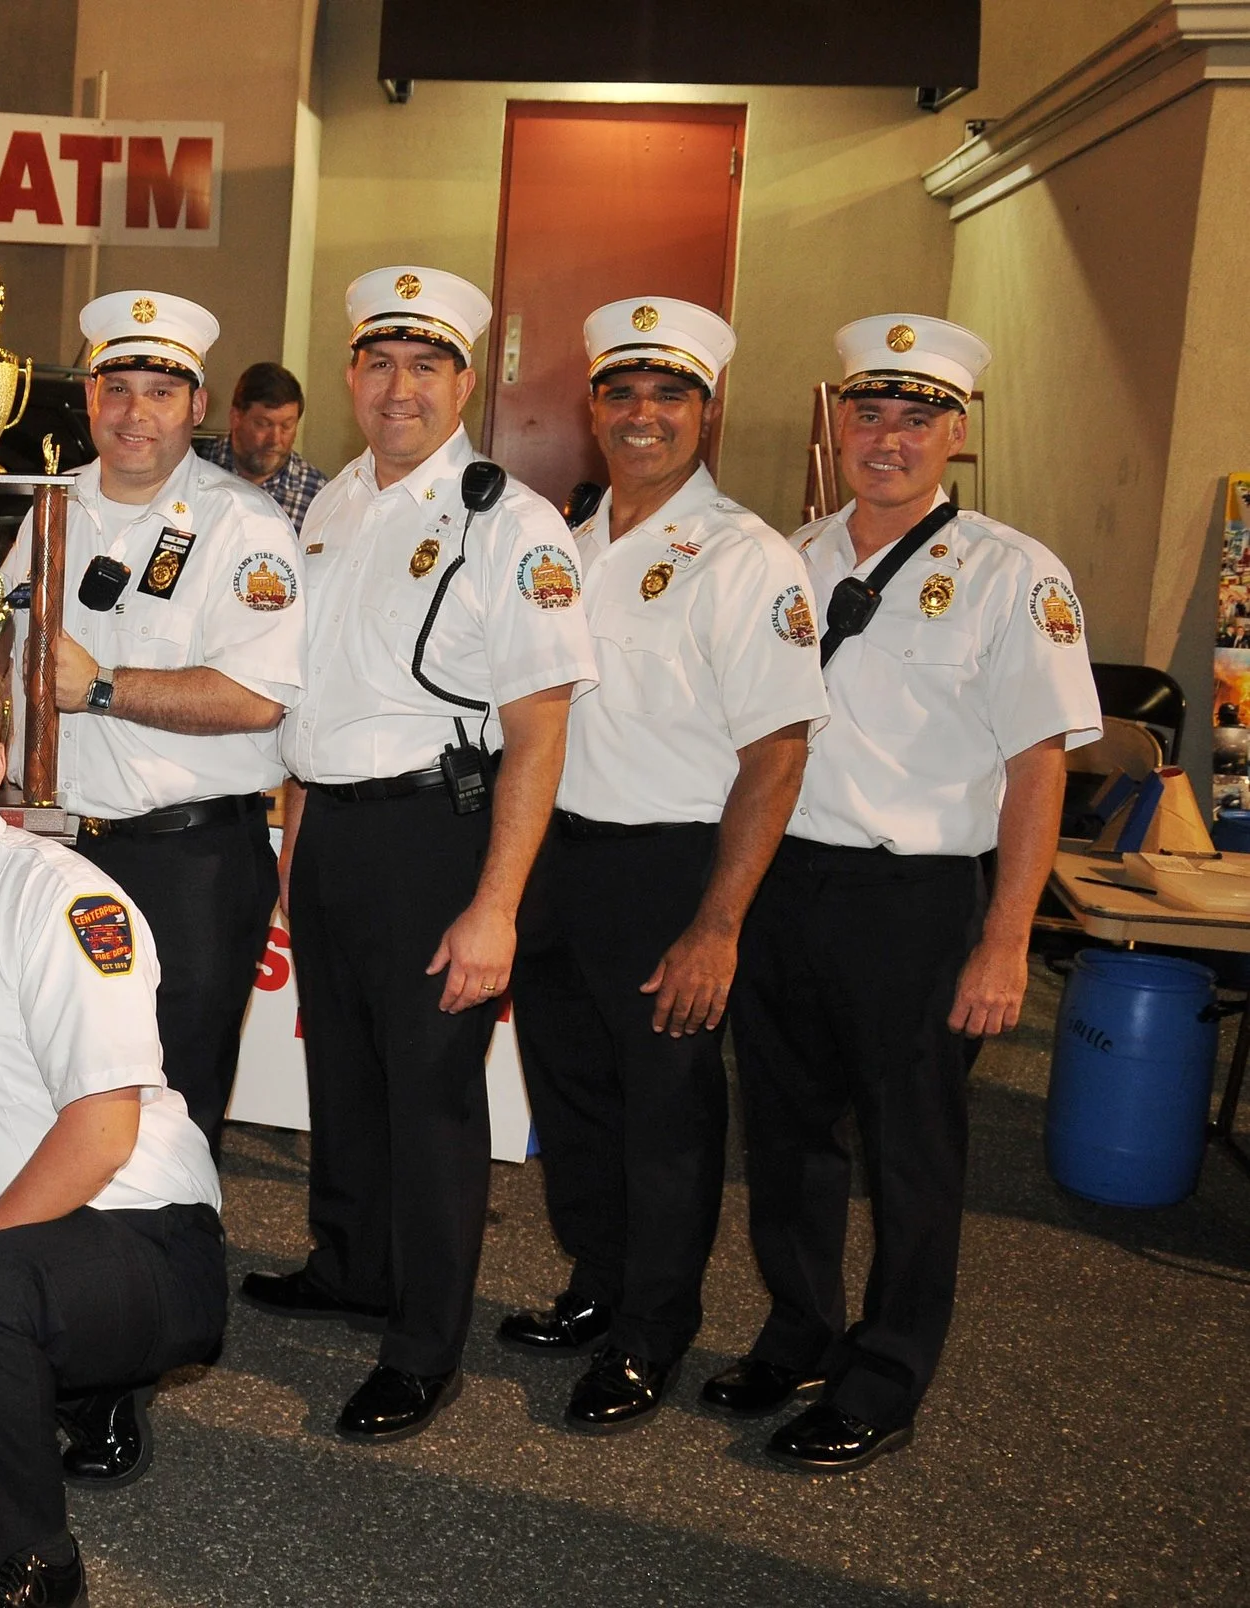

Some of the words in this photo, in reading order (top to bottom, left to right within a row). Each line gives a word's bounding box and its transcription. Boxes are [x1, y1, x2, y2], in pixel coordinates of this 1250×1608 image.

[254, 552, 273, 560] FIRE
[516, 551, 533, 600] GREENLAWN
[534, 545, 554, 553] FIRE
[771, 593, 790, 641] GREENLAWN
[74, 905, 122, 925] CENTERPORT
[112, 946, 129, 956] DEPT
